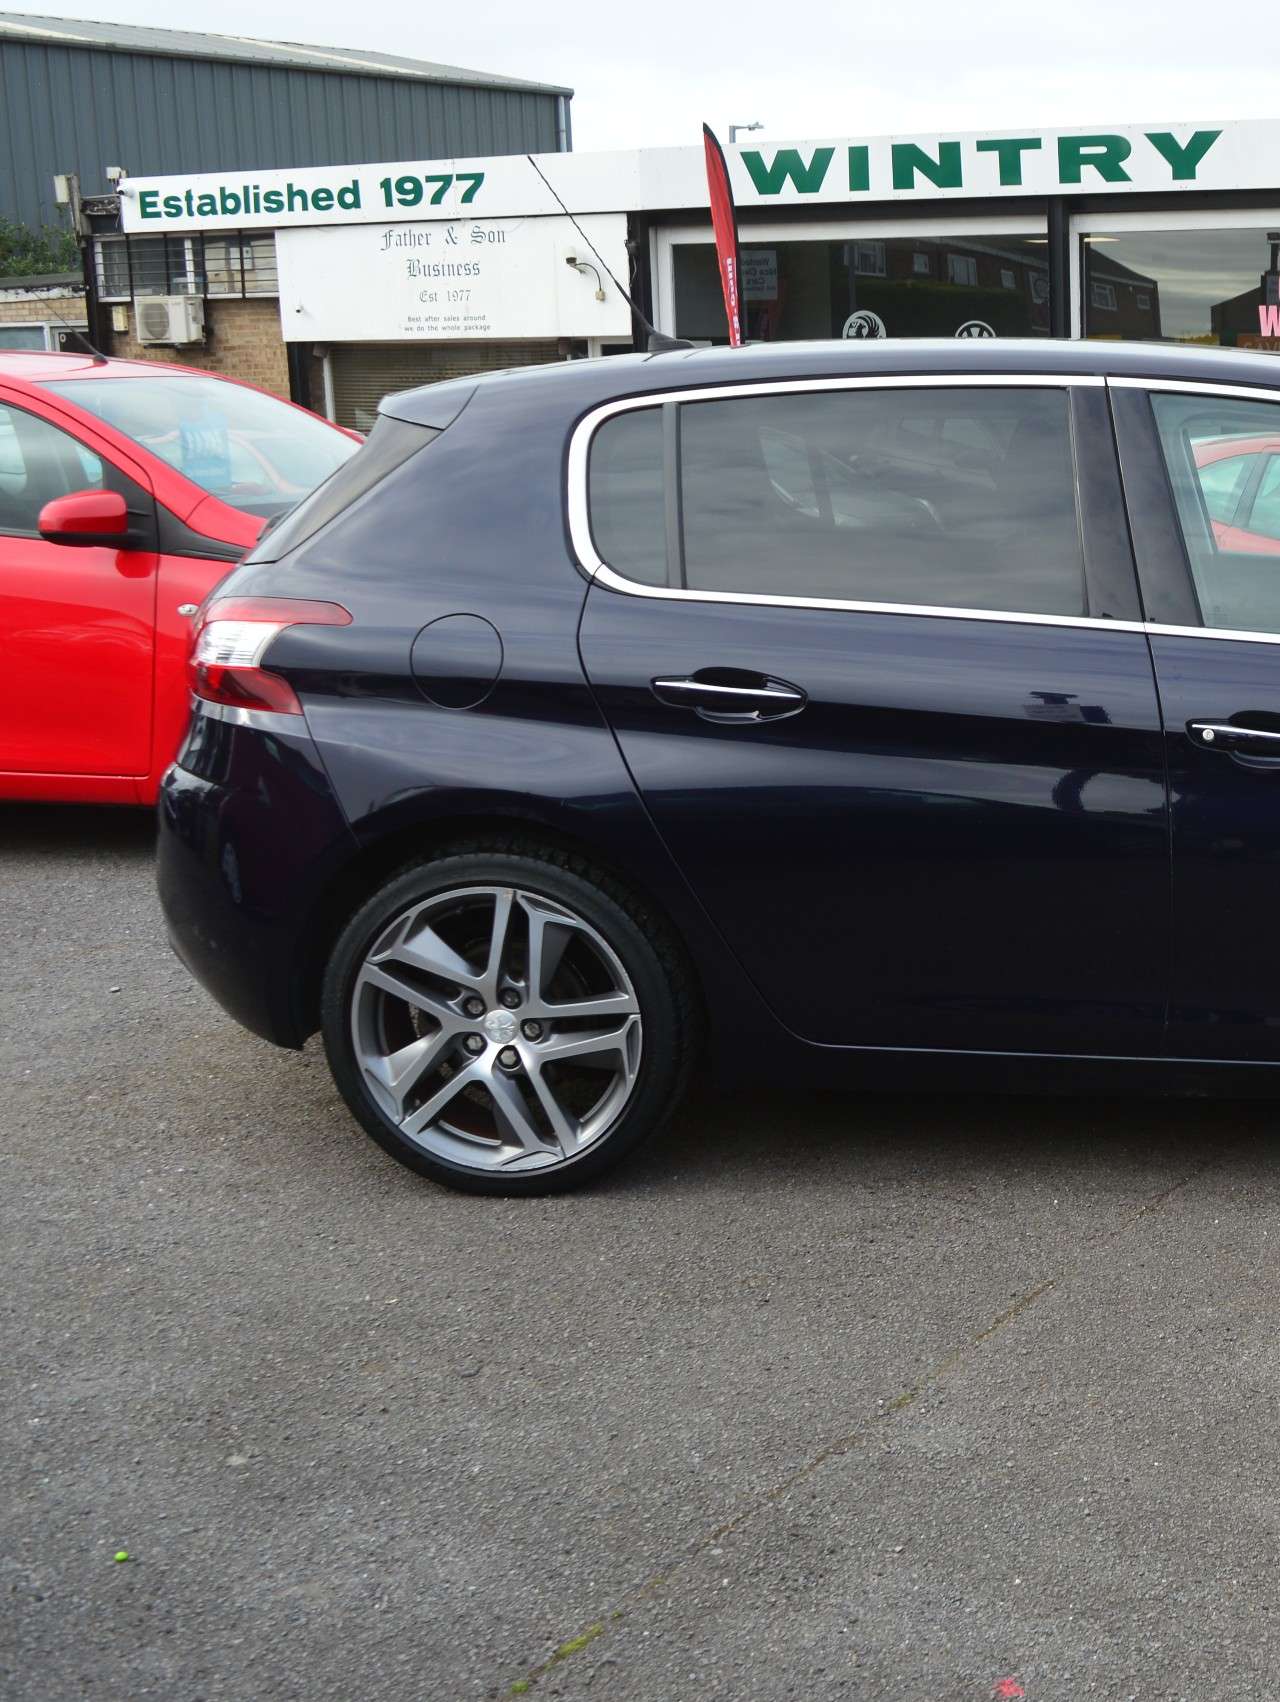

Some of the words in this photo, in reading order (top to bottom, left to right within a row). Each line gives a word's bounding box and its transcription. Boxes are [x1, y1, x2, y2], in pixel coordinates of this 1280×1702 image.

[740, 130, 1223, 195] WINTRY
[139, 179, 361, 219] Established
[380, 172, 485, 208] 1977
[380, 229, 432, 251] Father
[445, 226, 458, 245] &
[470, 225, 506, 244] Son
[406, 259, 481, 277] Business
[419, 290, 438, 302] Est
[447, 289, 471, 302] 1977
[424, 314, 440, 322] after
[443, 314, 460, 322] sales
